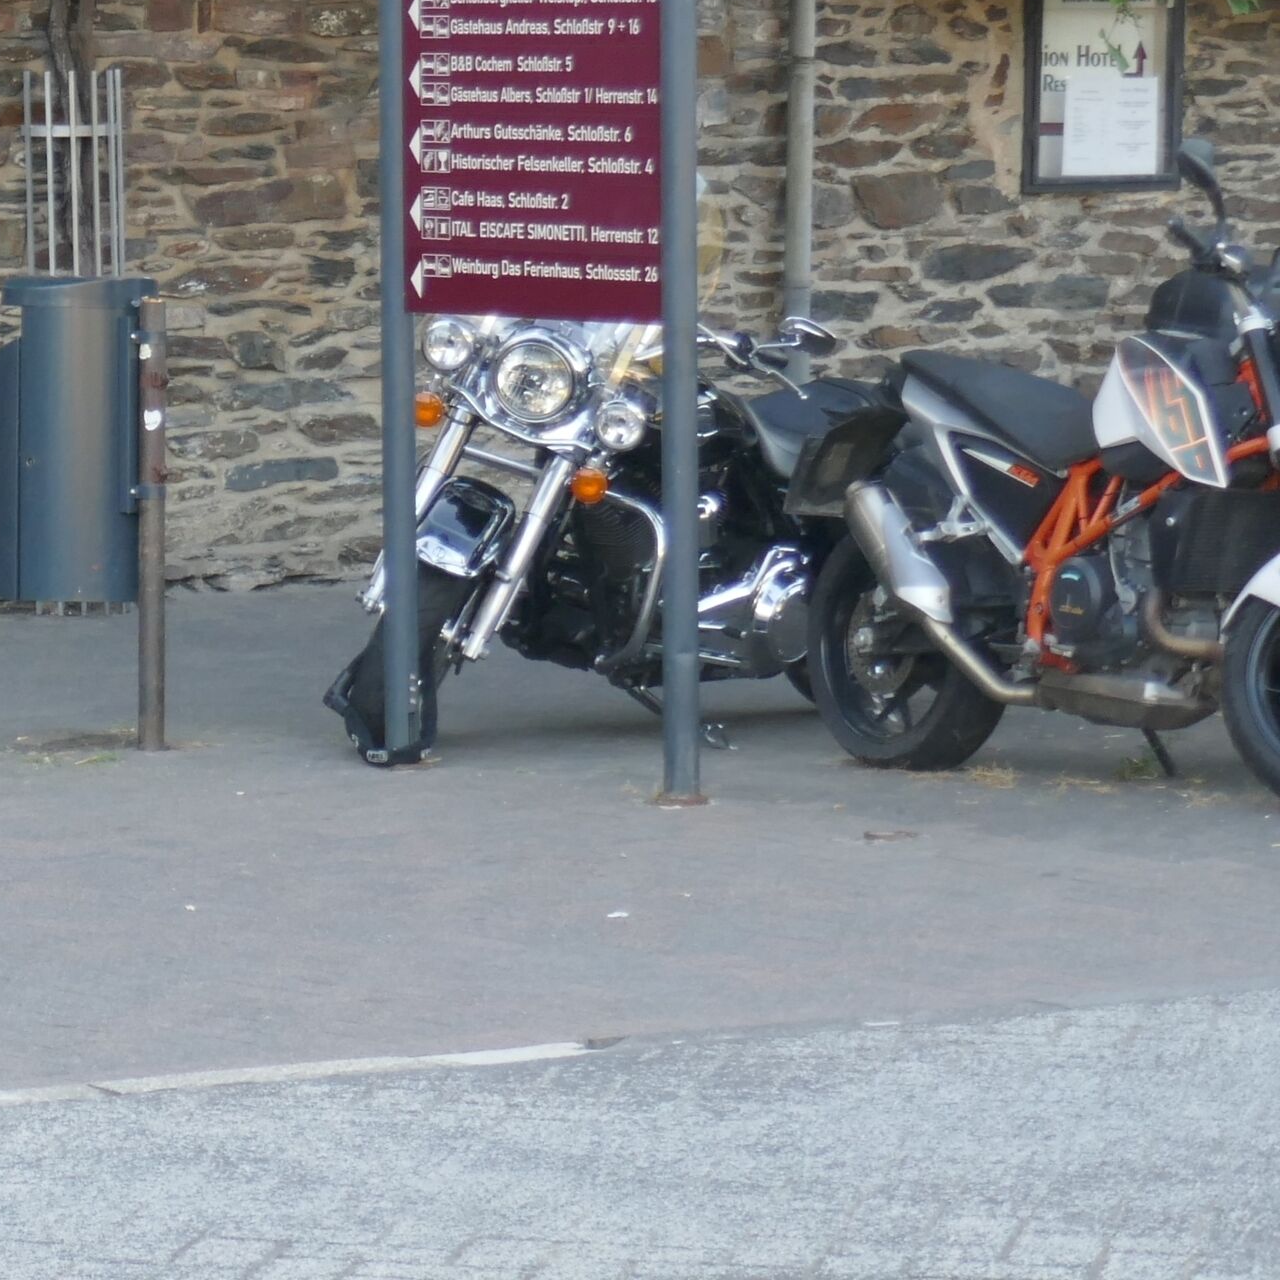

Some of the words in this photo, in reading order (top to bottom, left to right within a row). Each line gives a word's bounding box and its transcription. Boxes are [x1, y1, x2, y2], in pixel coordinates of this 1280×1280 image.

[450, 18, 503, 35] Gästehaus
[608, 18, 616, 35] 9
[629, 18, 640, 35] 16
[451, 55, 472, 71] B&B
[475, 55, 513, 72] Cochem
[565, 55, 573, 72] 5
[647, 87, 658, 105] 14
[451, 123, 491, 140] Arthurs
[624, 125, 633, 143] 6
[451, 153, 515, 171] Historischer
[645, 157, 655, 175] 4
[451, 190, 474, 207] Cafe
[561, 193, 569, 210] 2
[479, 221, 524, 239] EISCAFE
[591, 225, 644, 244] Herrenstr.
[647, 227, 659, 245] 12
[452, 257, 499, 279] Weinburg
[501, 260, 521, 277] Das
[645, 265, 659, 283] 26
